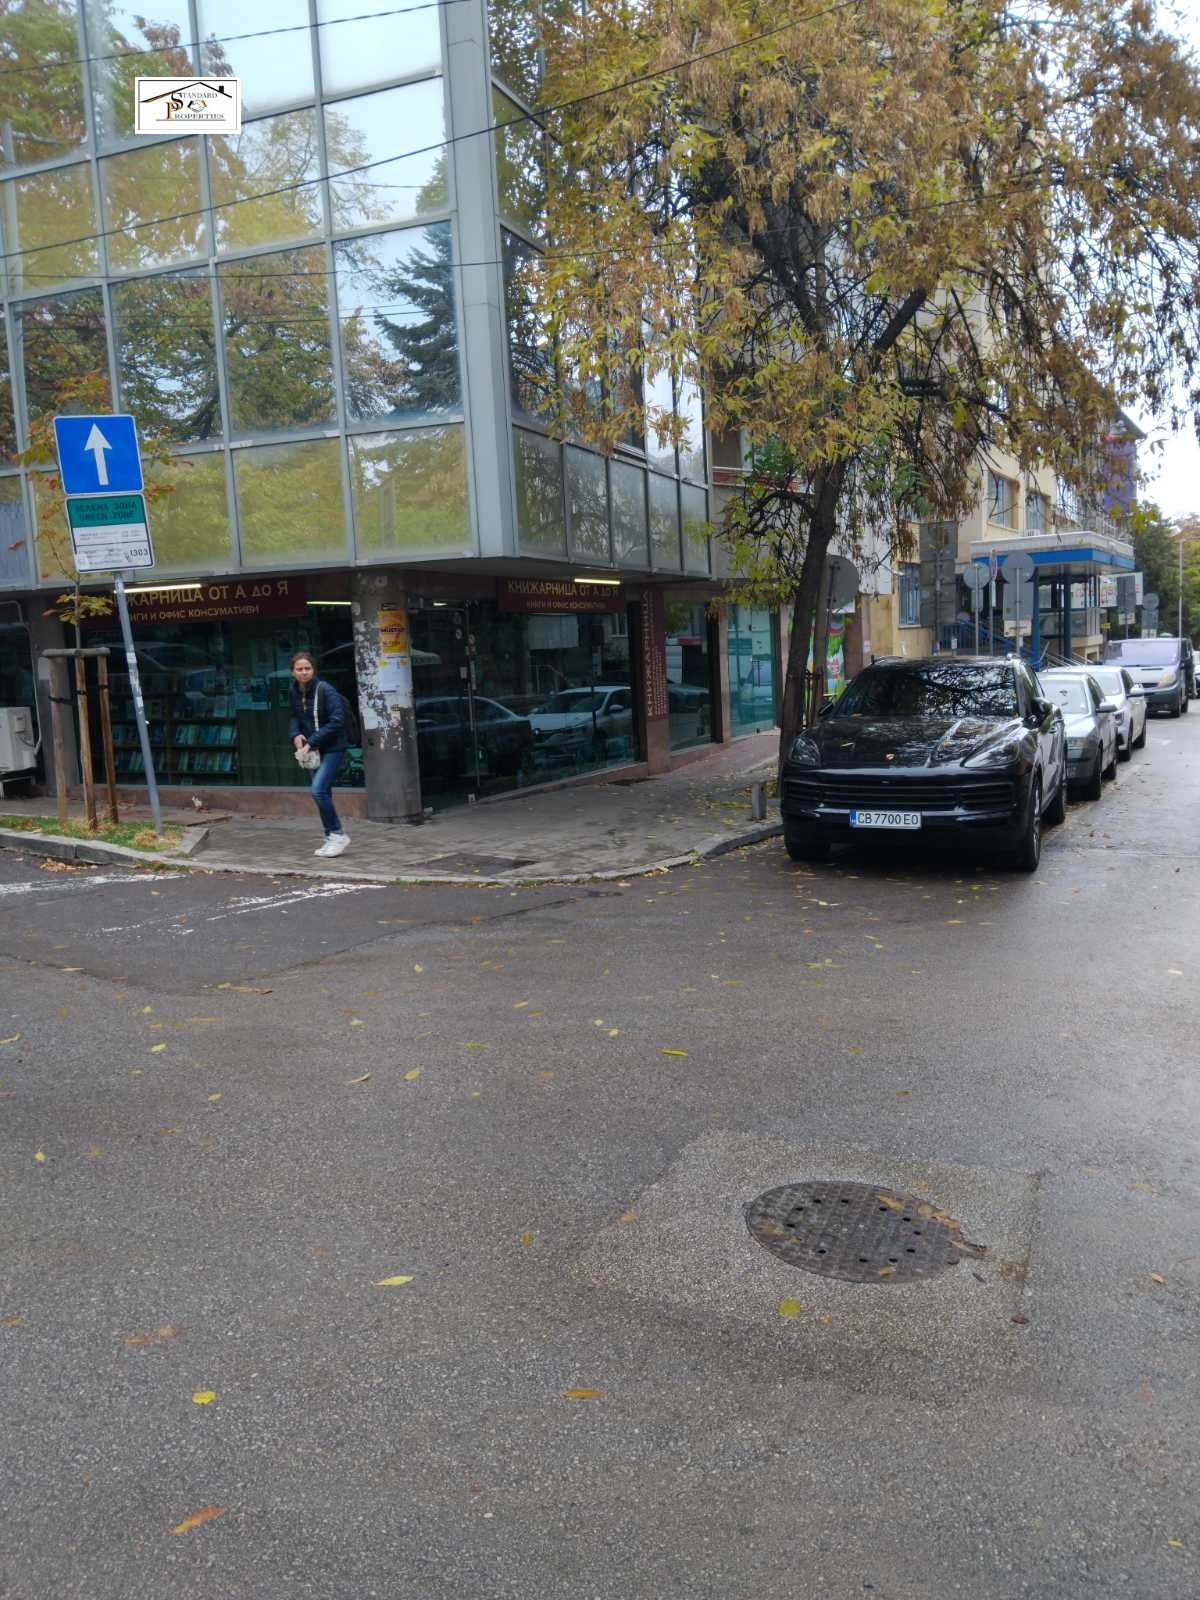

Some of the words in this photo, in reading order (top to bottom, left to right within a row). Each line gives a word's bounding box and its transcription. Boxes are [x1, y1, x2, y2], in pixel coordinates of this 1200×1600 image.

[208, 585, 229, 600] ОТ
[235, 584, 248, 599] А
[277, 581, 289, 595] Я
[159, 609, 187, 620] ОФИС
[188, 606, 260, 618] КОНСУМАТИВИ
[874, 813, 902, 825] 7700
